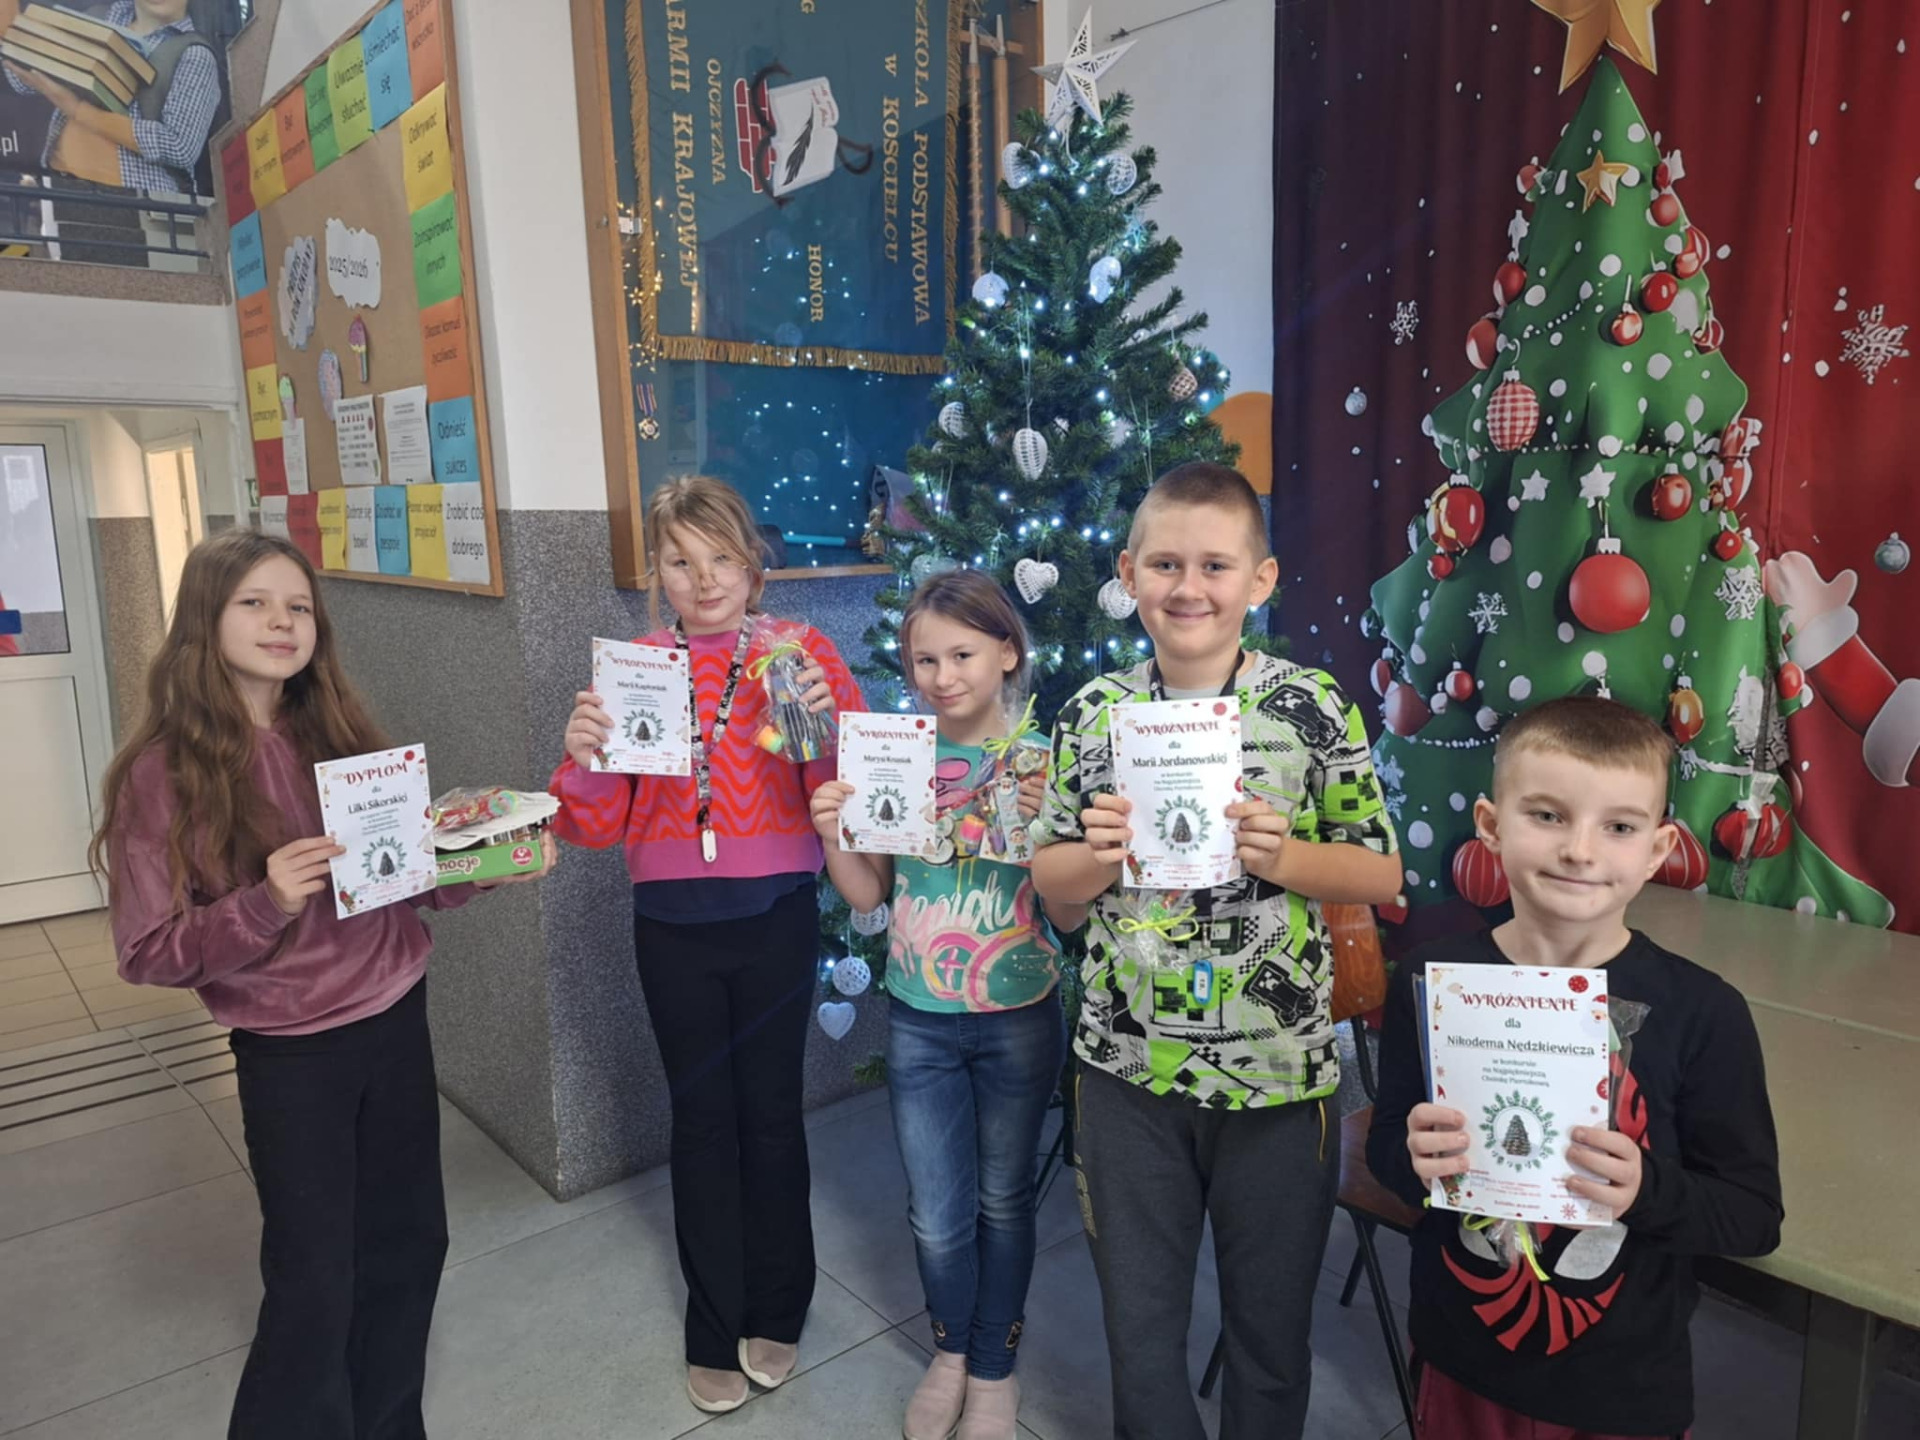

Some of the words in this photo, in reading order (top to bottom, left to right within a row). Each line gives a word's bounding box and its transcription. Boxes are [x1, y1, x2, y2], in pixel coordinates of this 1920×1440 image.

[364, 21, 400, 66] Uśmiechać
[380, 74, 391, 95] się
[341, 91, 367, 123] słuchać
[408, 107, 438, 144] Odkrywać
[706, 57, 726, 186] OJCZYZNA
[417, 150, 434, 173] świat
[672, 110, 699, 288] KRAJOWEJ
[413, 217, 454, 248] Zainspirować
[911, 130, 930, 326] PODSTAWOWA
[328, 254, 369, 279] 2025/2026
[426, 254, 446, 277] innych
[808, 244, 824, 323] HONOR
[437, 417, 467, 440] Odnieść
[445, 459, 467, 476] sukces
[363, 504, 372, 522] się
[446, 502, 469, 520] Zrobić
[470, 503, 485, 520] coś
[451, 537, 485, 560] dobrego
[1134, 721, 1219, 738] WYRÓŻNIENIE
[1168, 740, 1182, 750] dla
[1132, 757, 1157, 768] Marii
[1158, 753, 1227, 768] Jordanowskiej
[343, 761, 410, 786] DYPLOM
[371, 785, 382, 794] dla
[1459, 993, 1579, 1012] WYRÓŻNIENIE
[1504, 1016, 1521, 1029] dla
[1447, 1035, 1504, 1050] Nikodema
[1507, 1039, 1595, 1056] Nędzkiewicza
